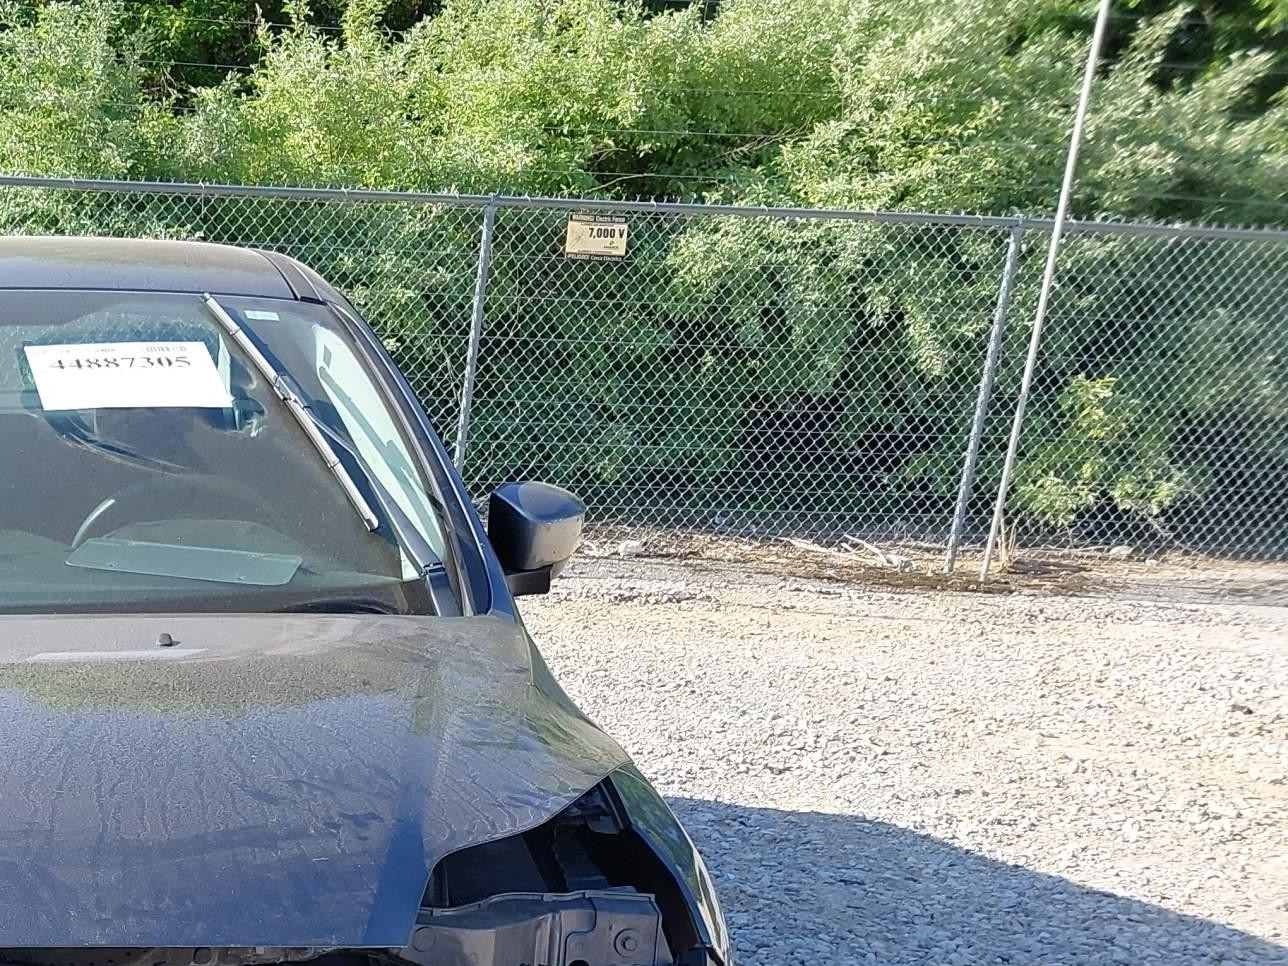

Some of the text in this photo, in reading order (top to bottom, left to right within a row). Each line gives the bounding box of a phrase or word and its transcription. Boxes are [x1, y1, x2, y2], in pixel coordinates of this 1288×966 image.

[589, 228, 625, 239] 7,000 V
[50, 356, 191, 370] 44887305
